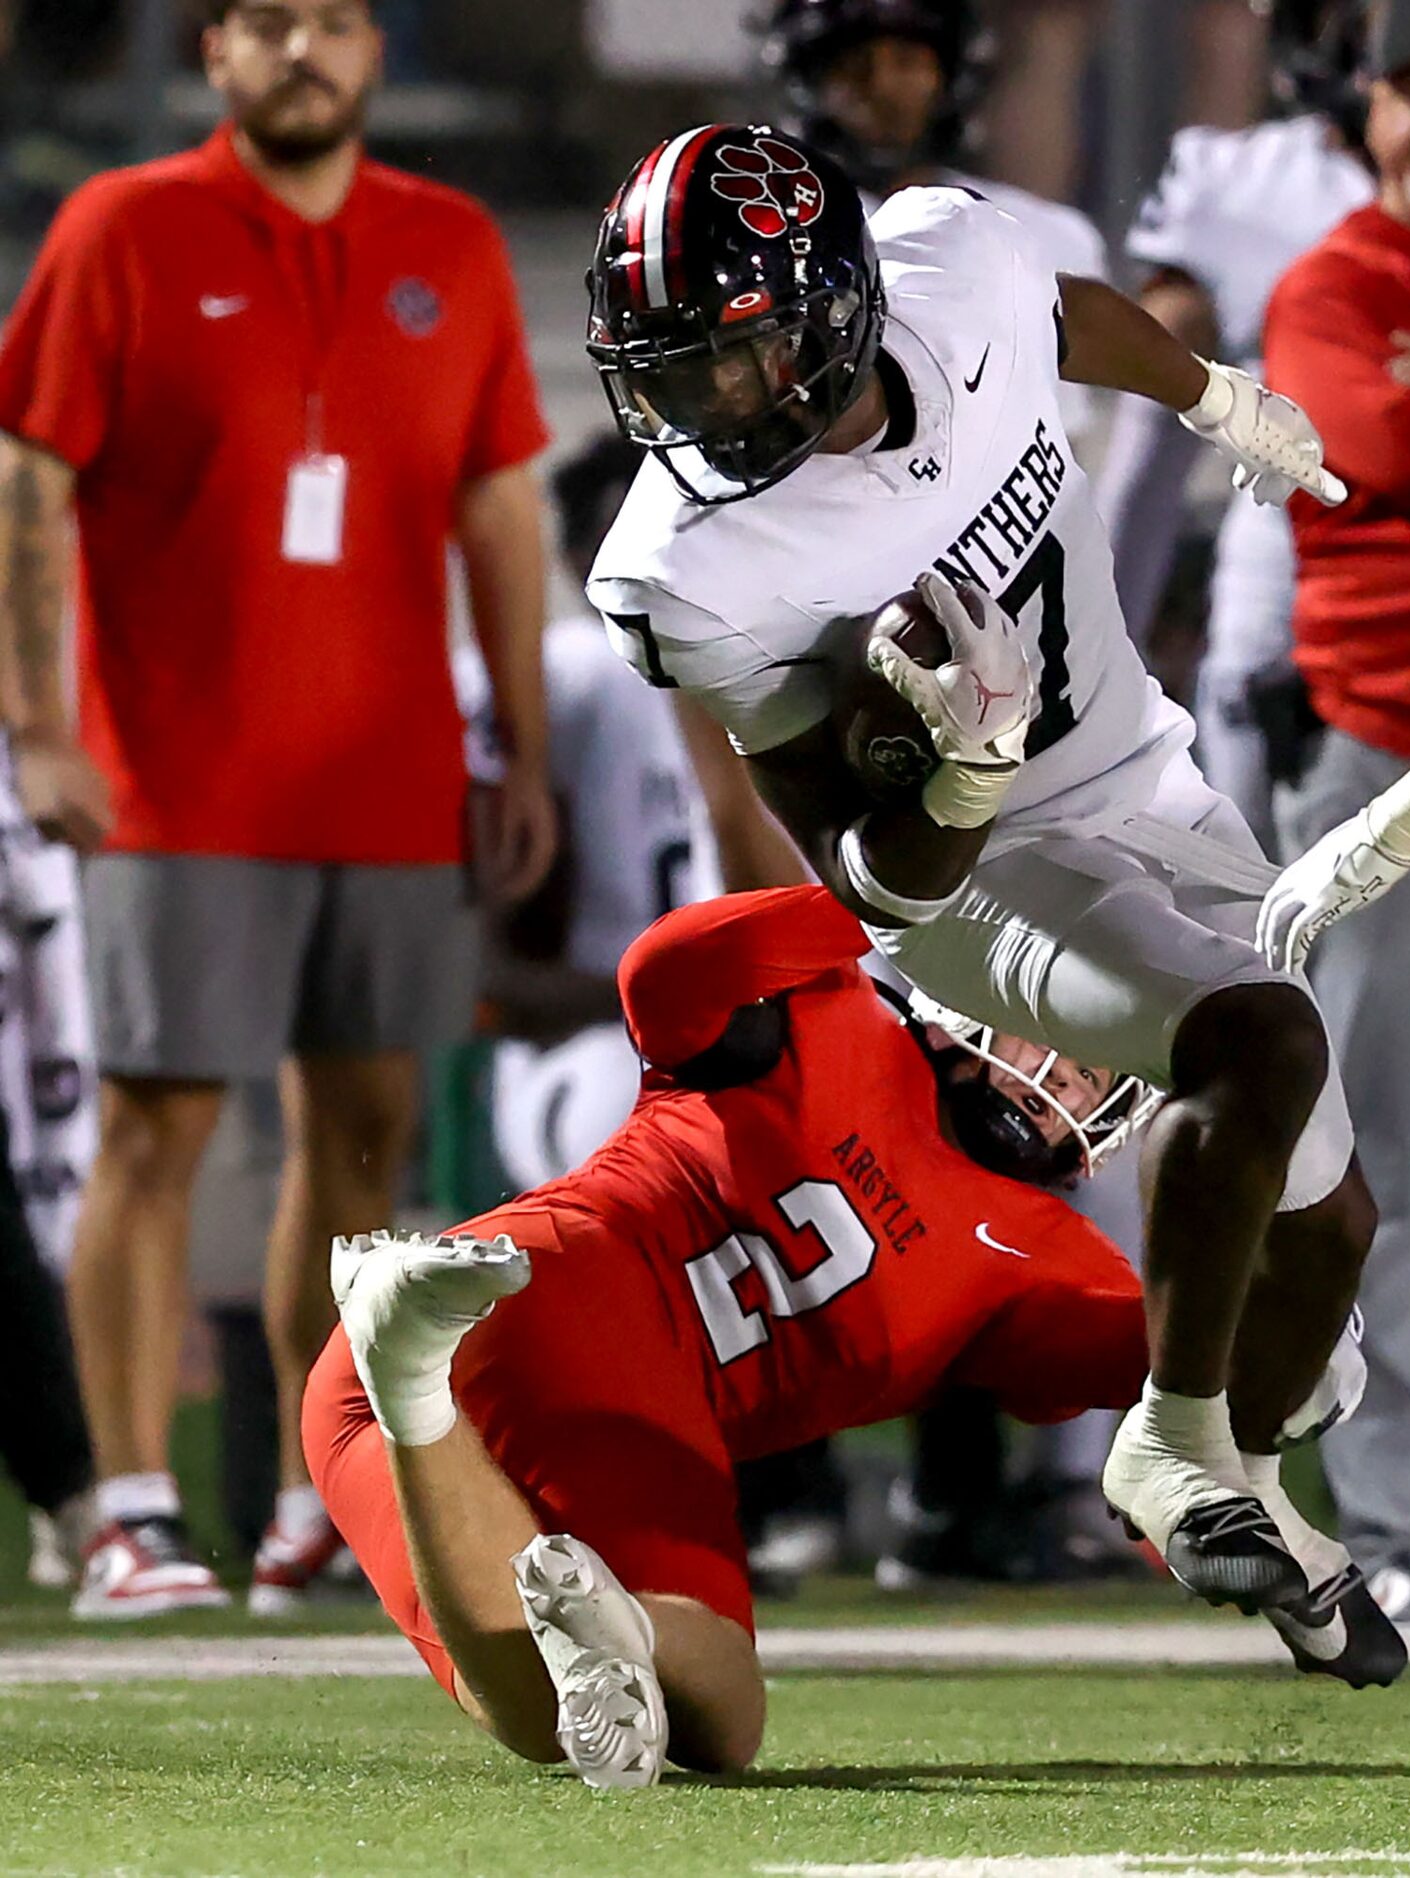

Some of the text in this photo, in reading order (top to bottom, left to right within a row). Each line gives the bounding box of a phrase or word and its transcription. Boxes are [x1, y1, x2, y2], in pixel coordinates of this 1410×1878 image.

[908, 456, 942, 482] CH
[912, 417, 1066, 595] NTHERS
[994, 529, 1081, 762] 7
[684, 1176, 877, 1368] 2
[832, 1132, 927, 1255] ARGYLE
